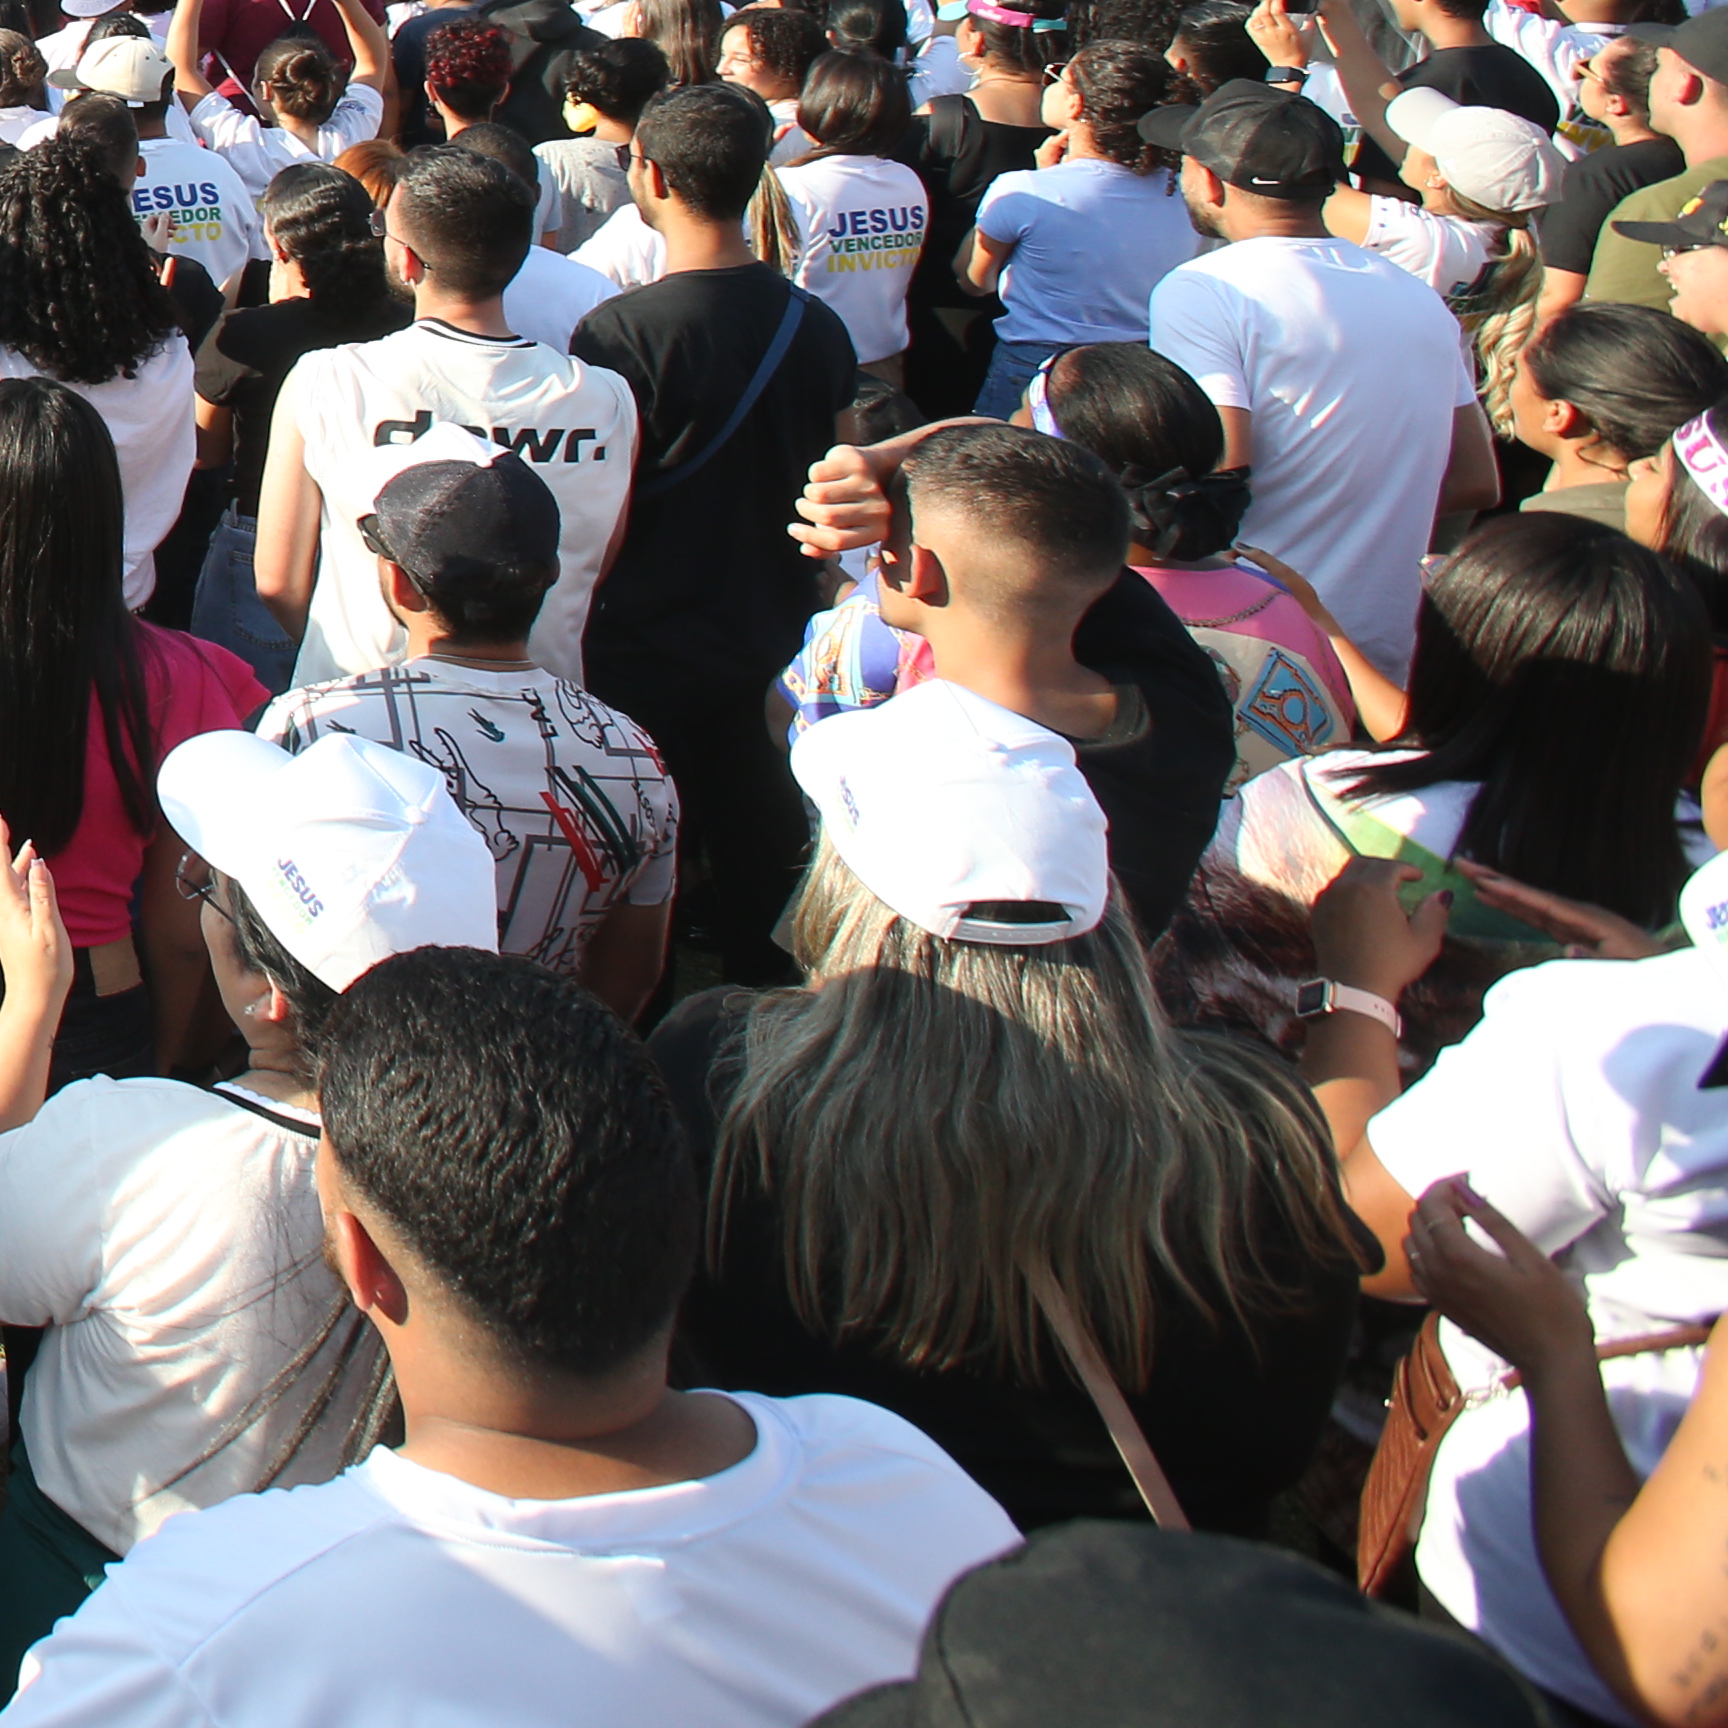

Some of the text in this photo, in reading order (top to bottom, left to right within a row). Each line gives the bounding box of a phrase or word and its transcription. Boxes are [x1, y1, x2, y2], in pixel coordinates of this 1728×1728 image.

[132, 182, 220, 222] ESUS
[827, 205, 924, 238] JESUS
[829, 231, 923, 254] VENCEDOR
[277, 858, 324, 919] JESUS
